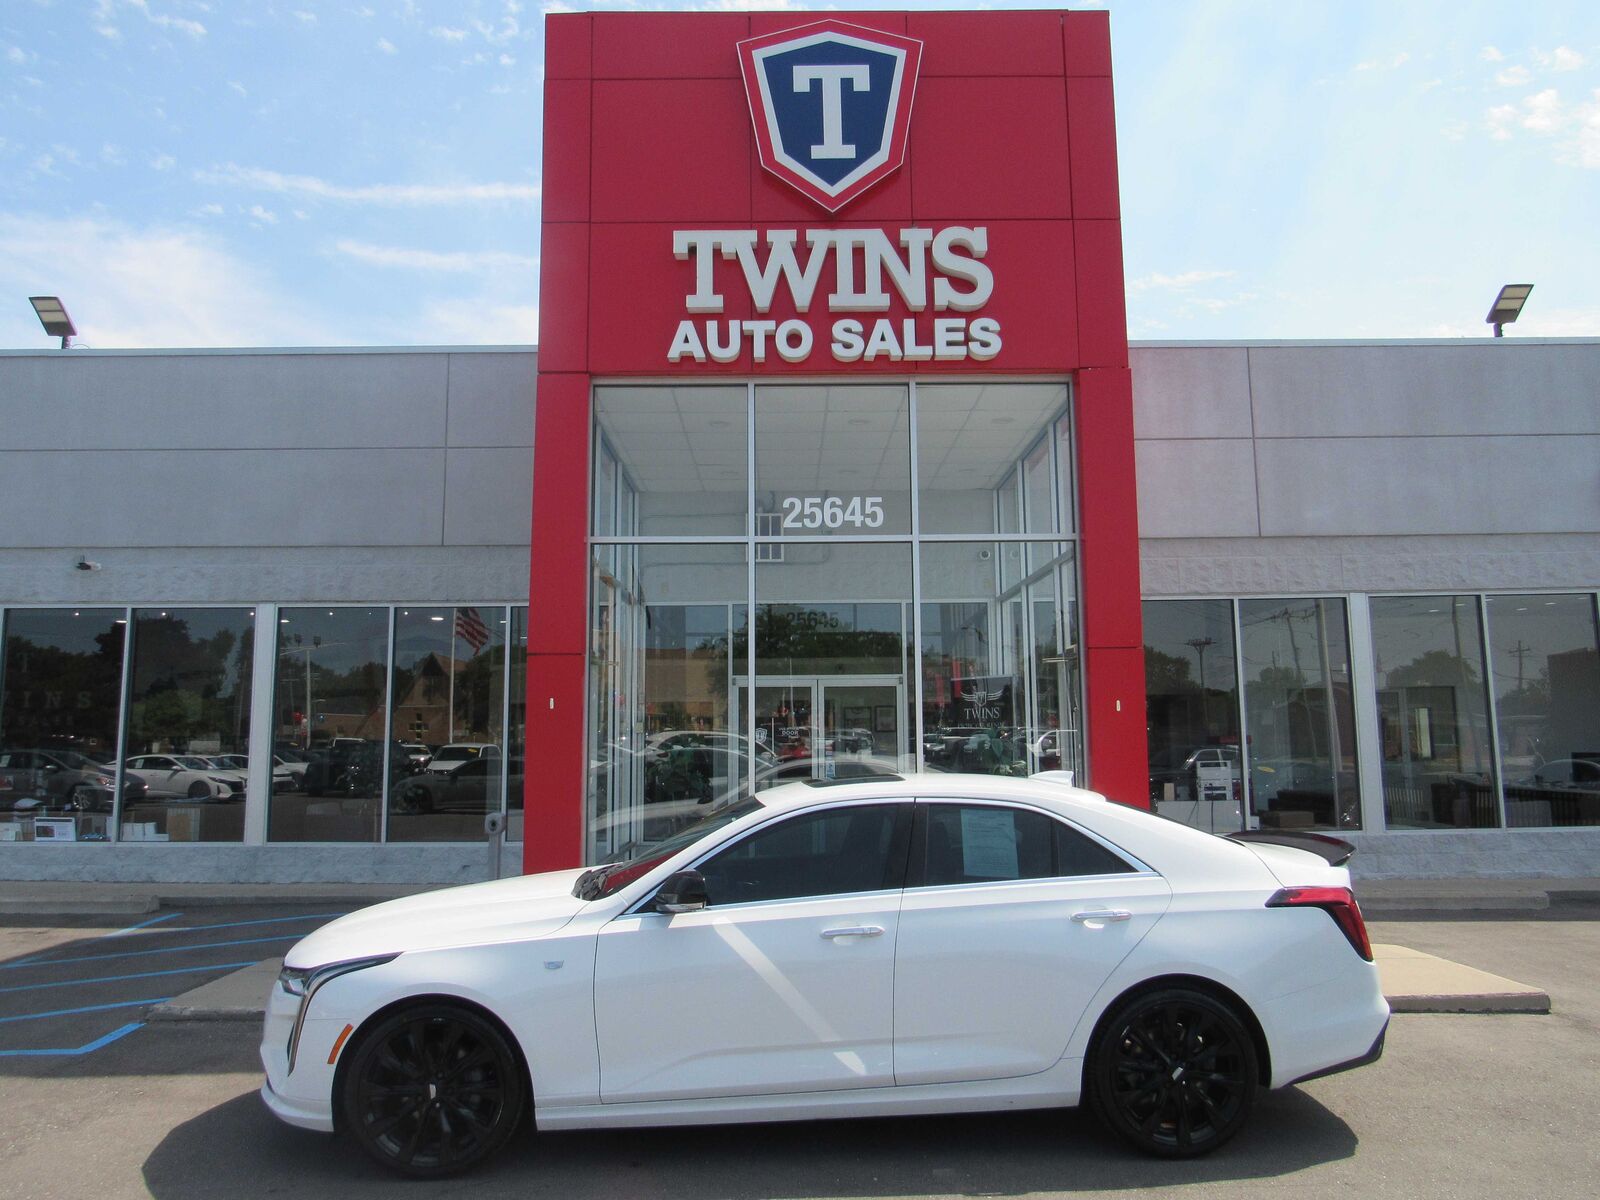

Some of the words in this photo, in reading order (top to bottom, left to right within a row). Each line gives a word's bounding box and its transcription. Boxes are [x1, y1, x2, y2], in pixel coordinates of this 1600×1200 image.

[793, 65, 870, 159] T
[673, 227, 994, 313] TWINS
[667, 319, 814, 363] AUTO
[831, 318, 1002, 362] SALES
[782, 496, 884, 528] 25645
[964, 707, 1001, 720] TWINS
